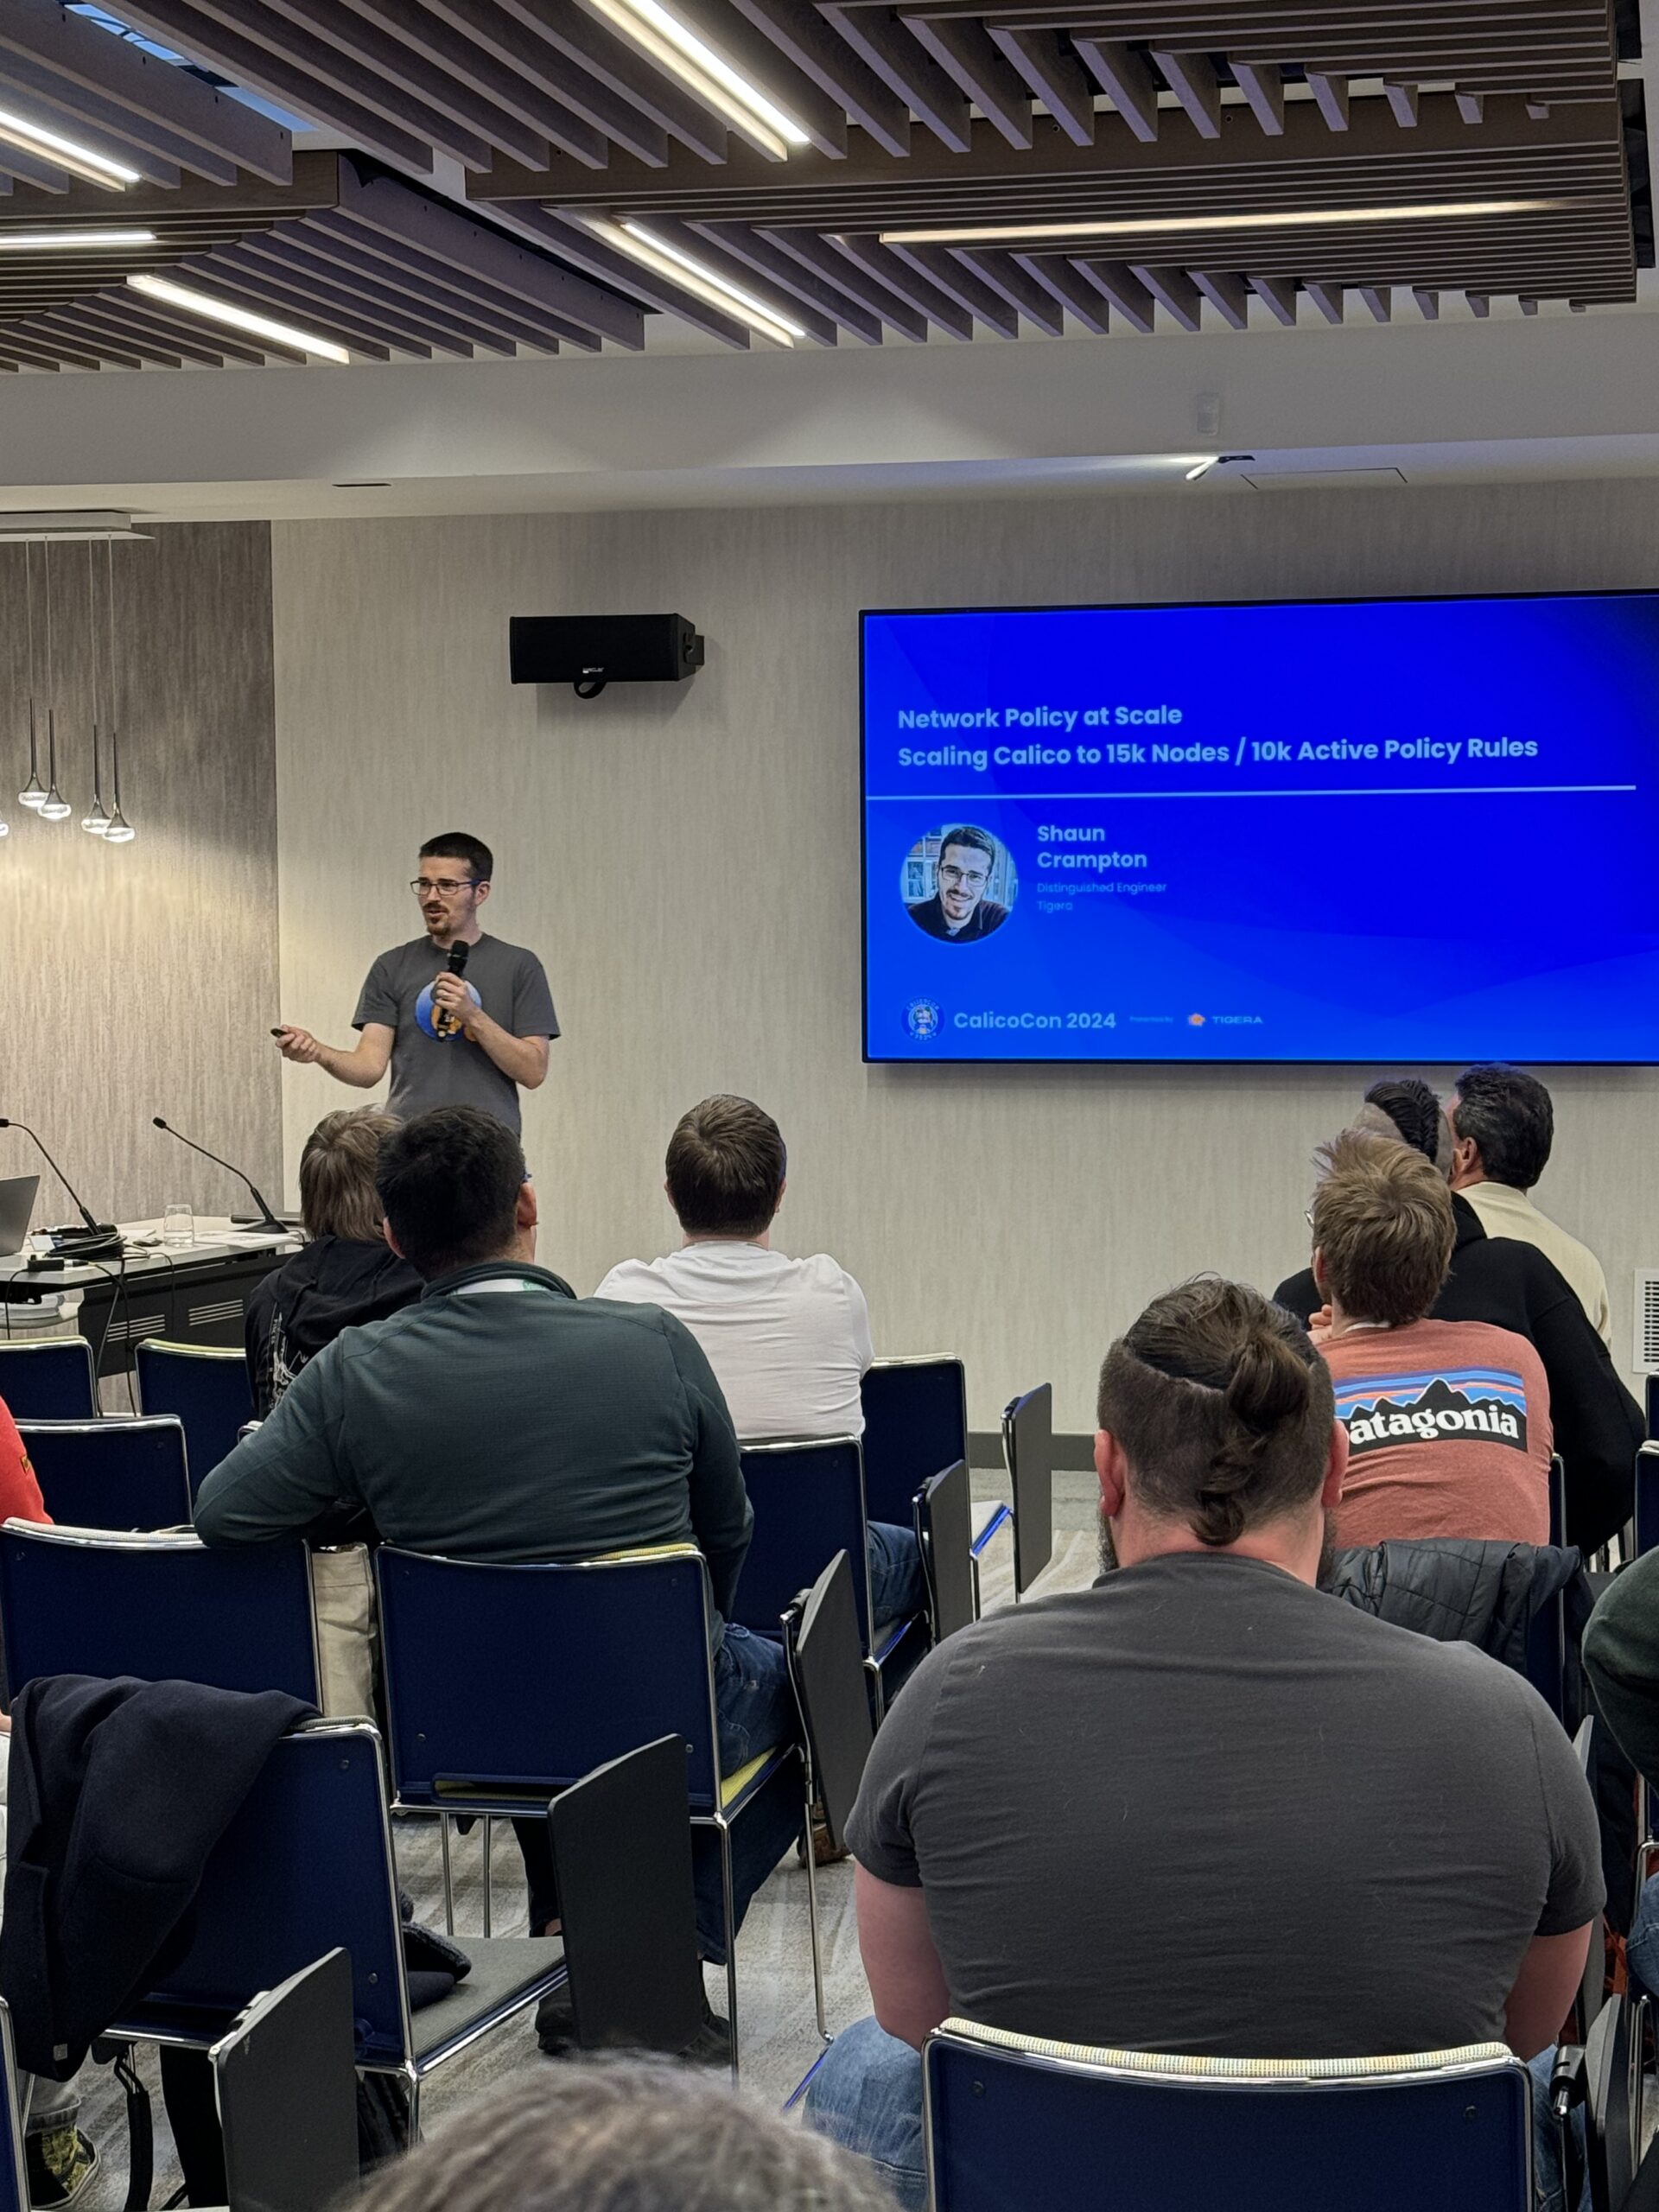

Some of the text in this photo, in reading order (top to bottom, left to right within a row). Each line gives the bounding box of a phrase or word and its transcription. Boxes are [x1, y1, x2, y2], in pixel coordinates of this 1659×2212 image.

[899, 705, 1183, 732] Network Policy at Scale
[899, 736, 1538, 772] Scaling Calico to 15k Nodes / 10k Active Policy Rules
[1037, 824, 1105, 842] Shaun
[1037, 851, 1147, 874] Crampton
[1037, 882, 1166, 895] Distinguished Engineer
[1037, 900, 1073, 913] Tigera
[954, 1011, 1061, 1028] CalicoCon
[1066, 1013, 1116, 1028] 2024
[1212, 1015, 1263, 1024] TIGERA
[1349, 1404, 1519, 1444] atagonia
